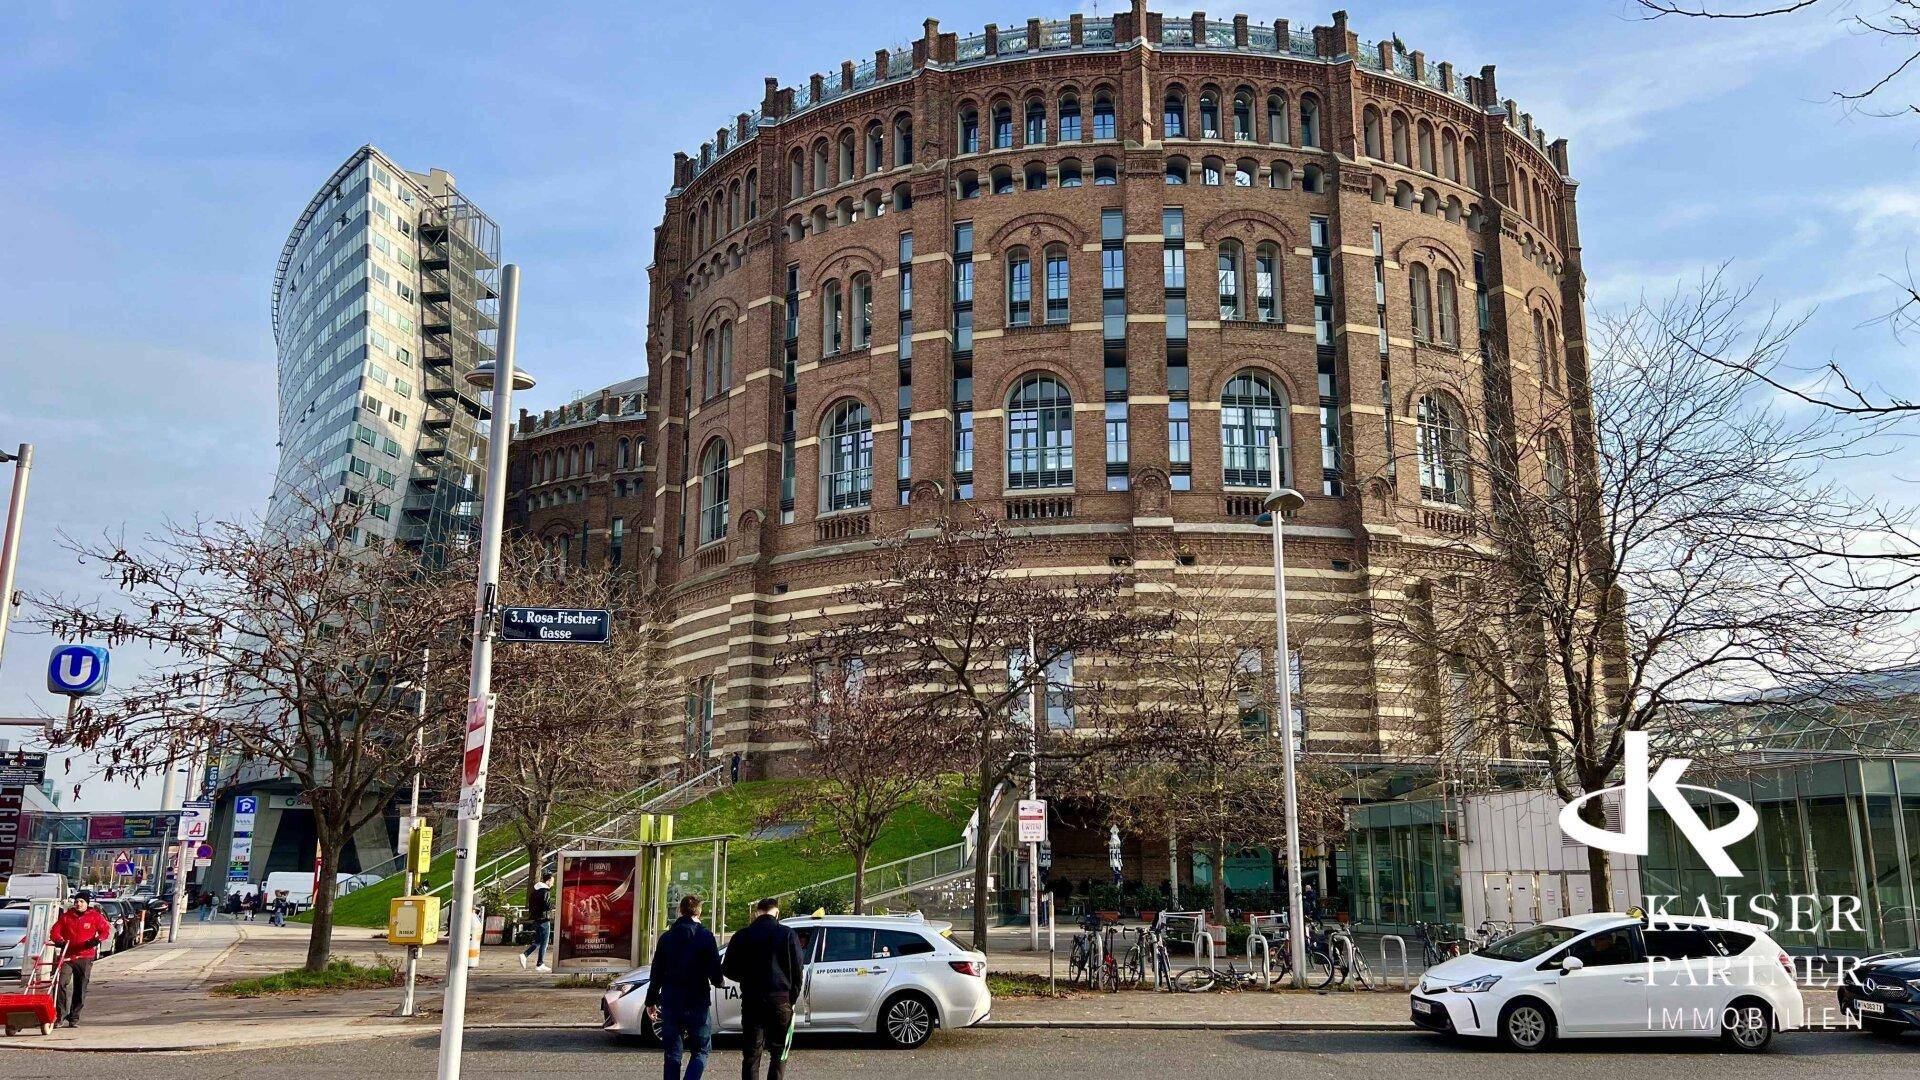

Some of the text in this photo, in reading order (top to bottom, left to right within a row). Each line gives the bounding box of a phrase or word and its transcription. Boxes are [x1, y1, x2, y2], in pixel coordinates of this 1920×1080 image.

[526, 611, 601, 625] Rosa-Fischer-
[540, 626, 572, 639] Gasse
[60, 654, 93, 686] U
[722, 986, 742, 1000] TA
